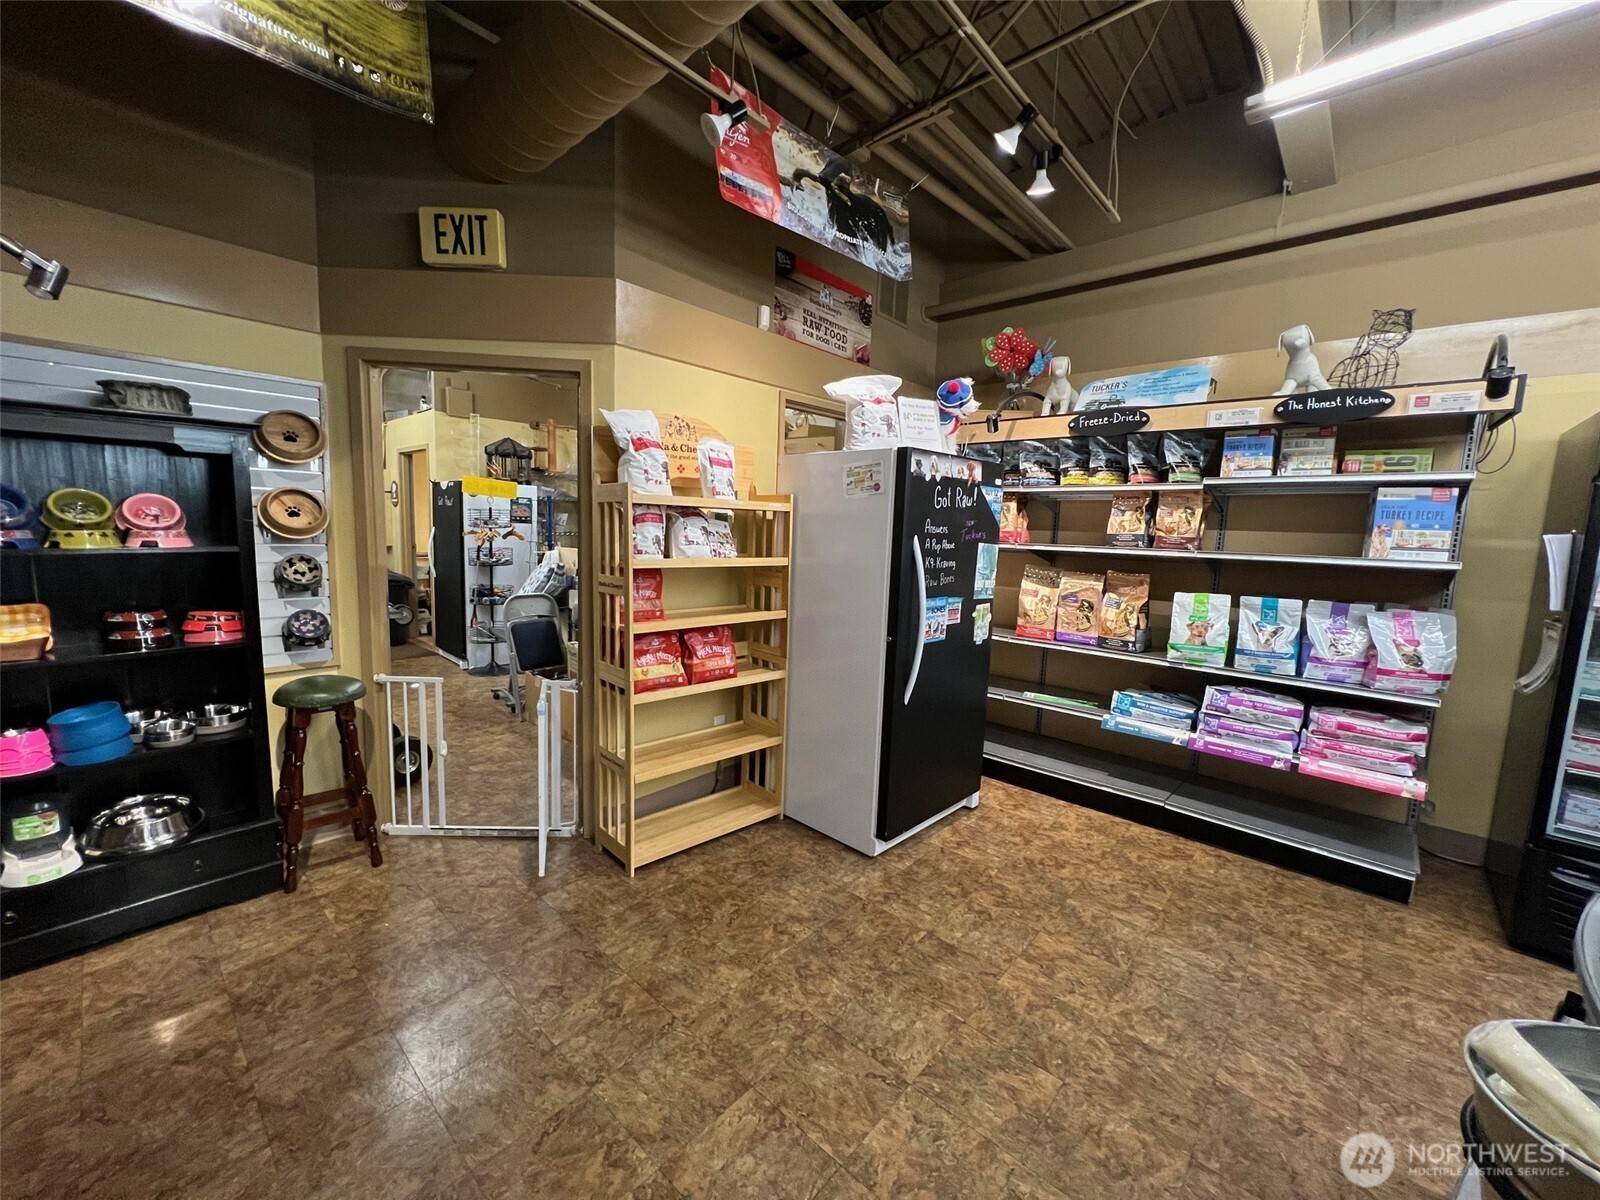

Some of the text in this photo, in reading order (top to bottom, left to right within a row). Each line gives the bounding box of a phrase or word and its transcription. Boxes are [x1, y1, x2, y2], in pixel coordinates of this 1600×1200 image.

[433, 213, 488, 256] EXIT
[802, 307, 817, 320] REAL
[802, 315, 848, 345] RAW FOOD
[802, 327, 815, 340] FOR
[815, 332, 830, 346] DOGS
[1091, 380, 1128, 393] TUCKER'S
[1287, 395, 1387, 411] The Honest Kitchen
[1079, 411, 1141, 428] Freeze-Dried
[671, 443, 679, 451] &
[934, 485, 978, 509] Got Raw!
[1380, 509, 1446, 521] TURKEY RECIPE
[925, 518, 949, 534] Answers
[925, 538, 931, 550] A
[931, 538, 940, 554] Pup
[940, 572, 955, 587] Bones
[636, 653, 656, 668] MEAL
[696, 646, 713, 660] MEAL
